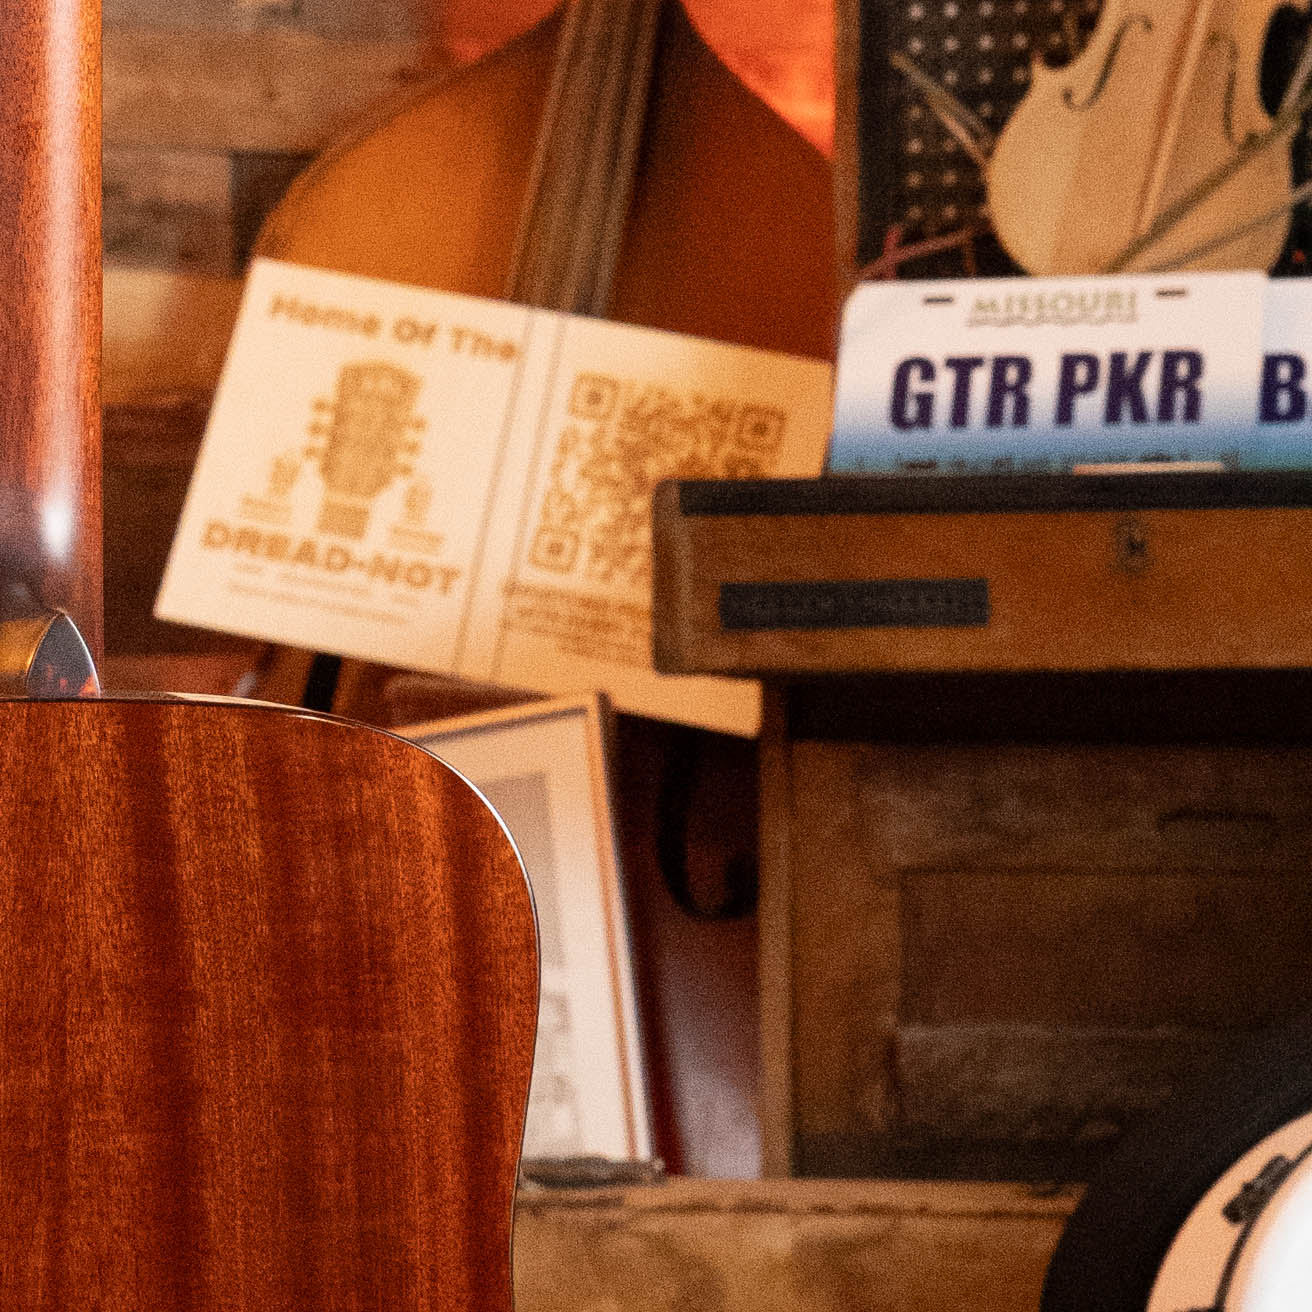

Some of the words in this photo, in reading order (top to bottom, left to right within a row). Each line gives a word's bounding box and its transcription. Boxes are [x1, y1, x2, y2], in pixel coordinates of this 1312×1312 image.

[269, 292, 381, 341] Home
[448, 326, 521, 362] The
[972, 288, 1138, 315] MISSOURI
[888, 354, 1033, 432] GTR
[1054, 349, 1205, 428] PKR
[199, 519, 463, 595] DREAD-NOT
